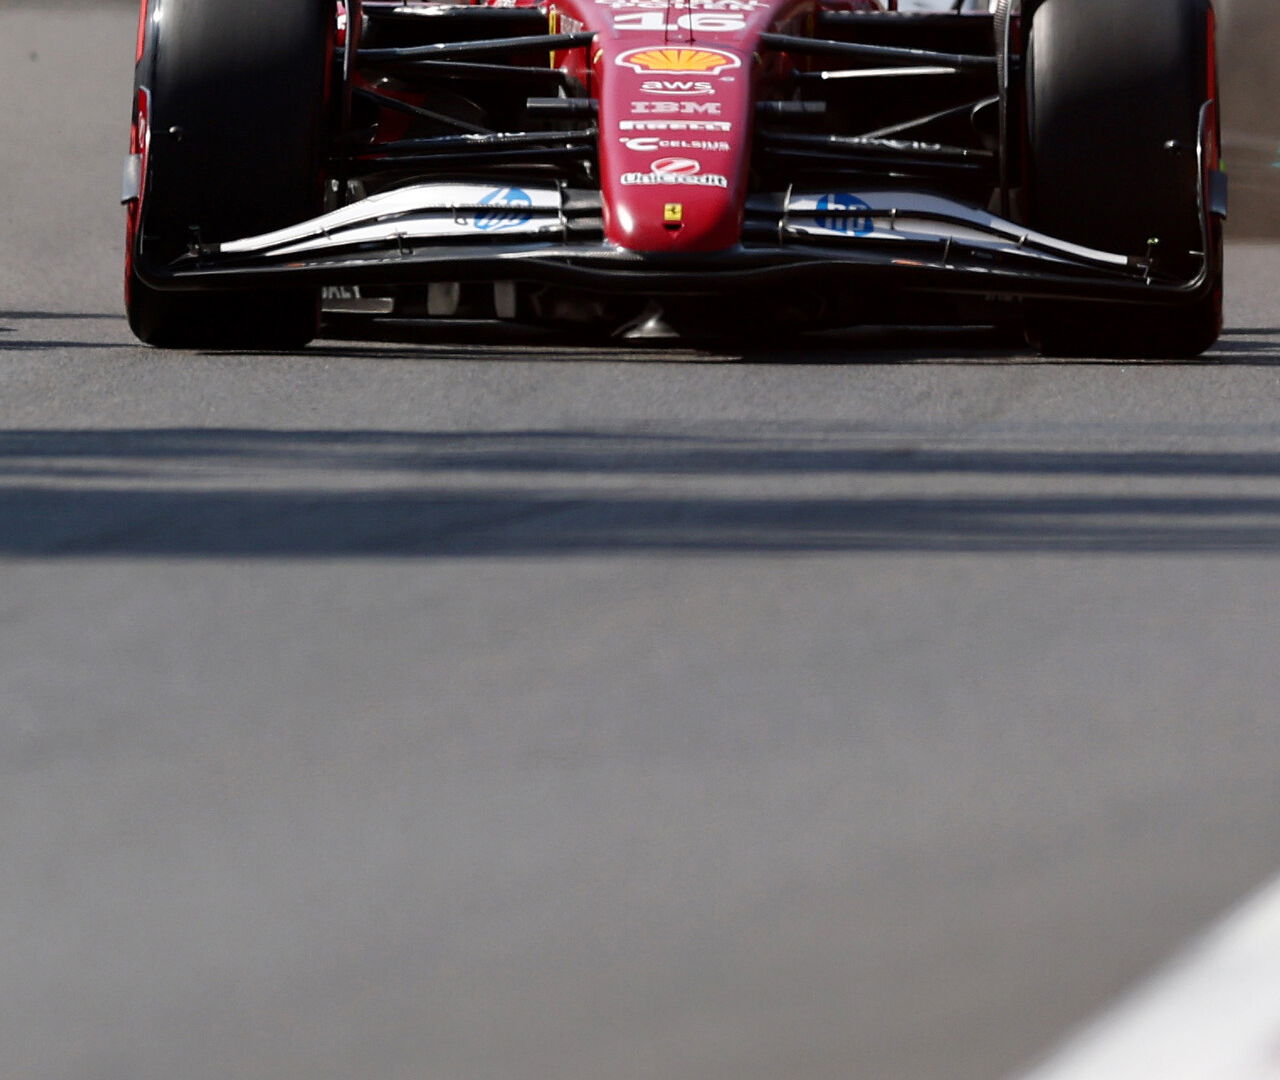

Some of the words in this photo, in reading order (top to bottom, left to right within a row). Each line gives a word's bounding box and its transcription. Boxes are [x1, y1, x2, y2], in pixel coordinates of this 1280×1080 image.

[614, 12, 747, 32] 16
[641, 81, 713, 91] aws
[631, 101, 721, 114] IBM
[622, 173, 726, 186] UniCredit
